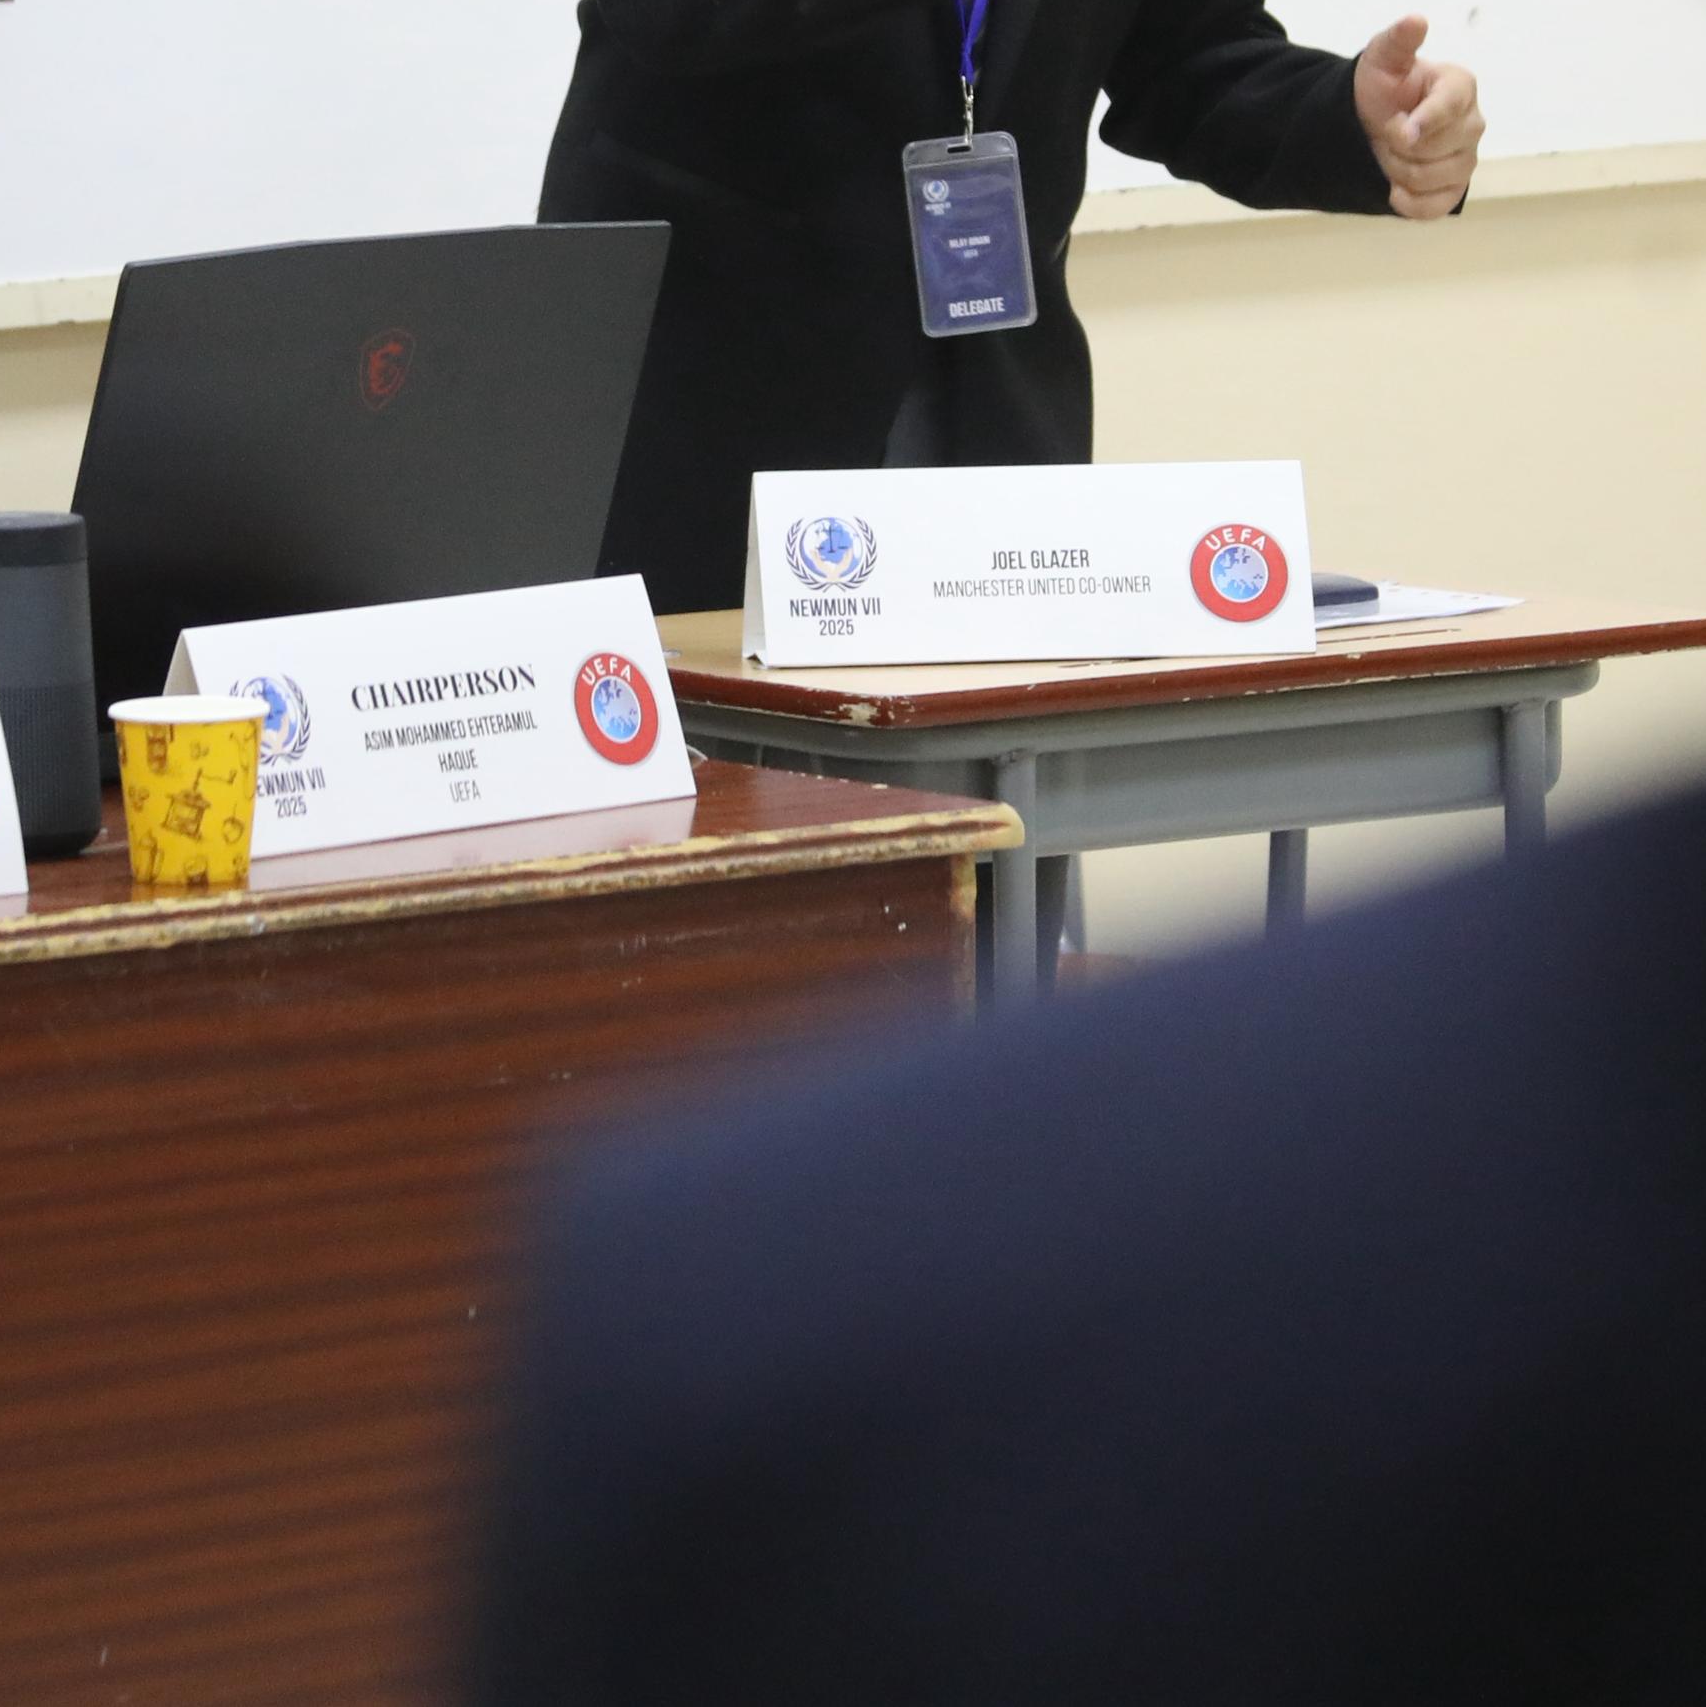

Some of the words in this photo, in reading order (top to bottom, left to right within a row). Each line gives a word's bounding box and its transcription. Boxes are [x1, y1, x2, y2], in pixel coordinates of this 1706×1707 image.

[948, 296, 1006, 318] DELEGATE
[1204, 526, 1267, 551] UEFA
[991, 550, 1026, 571] JOEL
[1031, 549, 1090, 569] GLAZER
[933, 579, 1026, 599] MANCHESTER
[1028, 577, 1075, 596] UNITED
[1078, 575, 1152, 595] CO-OWNER
[789, 598, 858, 618] NEWMUN
[861, 597, 881, 615] VII
[819, 619, 855, 636] 2025
[581, 656, 633, 687] UEFA
[350, 663, 537, 712] CHAIRPERSON
[364, 730, 393, 752] ASIM
[396, 720, 466, 747] MOHAMMED
[469, 710, 538, 738] EHTERAMUL
[438, 749, 478, 773] HAQUE
[256, 770, 306, 797] EWMUN
[306, 767, 326, 789] VII
[449, 780, 481, 803] UEFA
[274, 795, 307, 818] 2025
